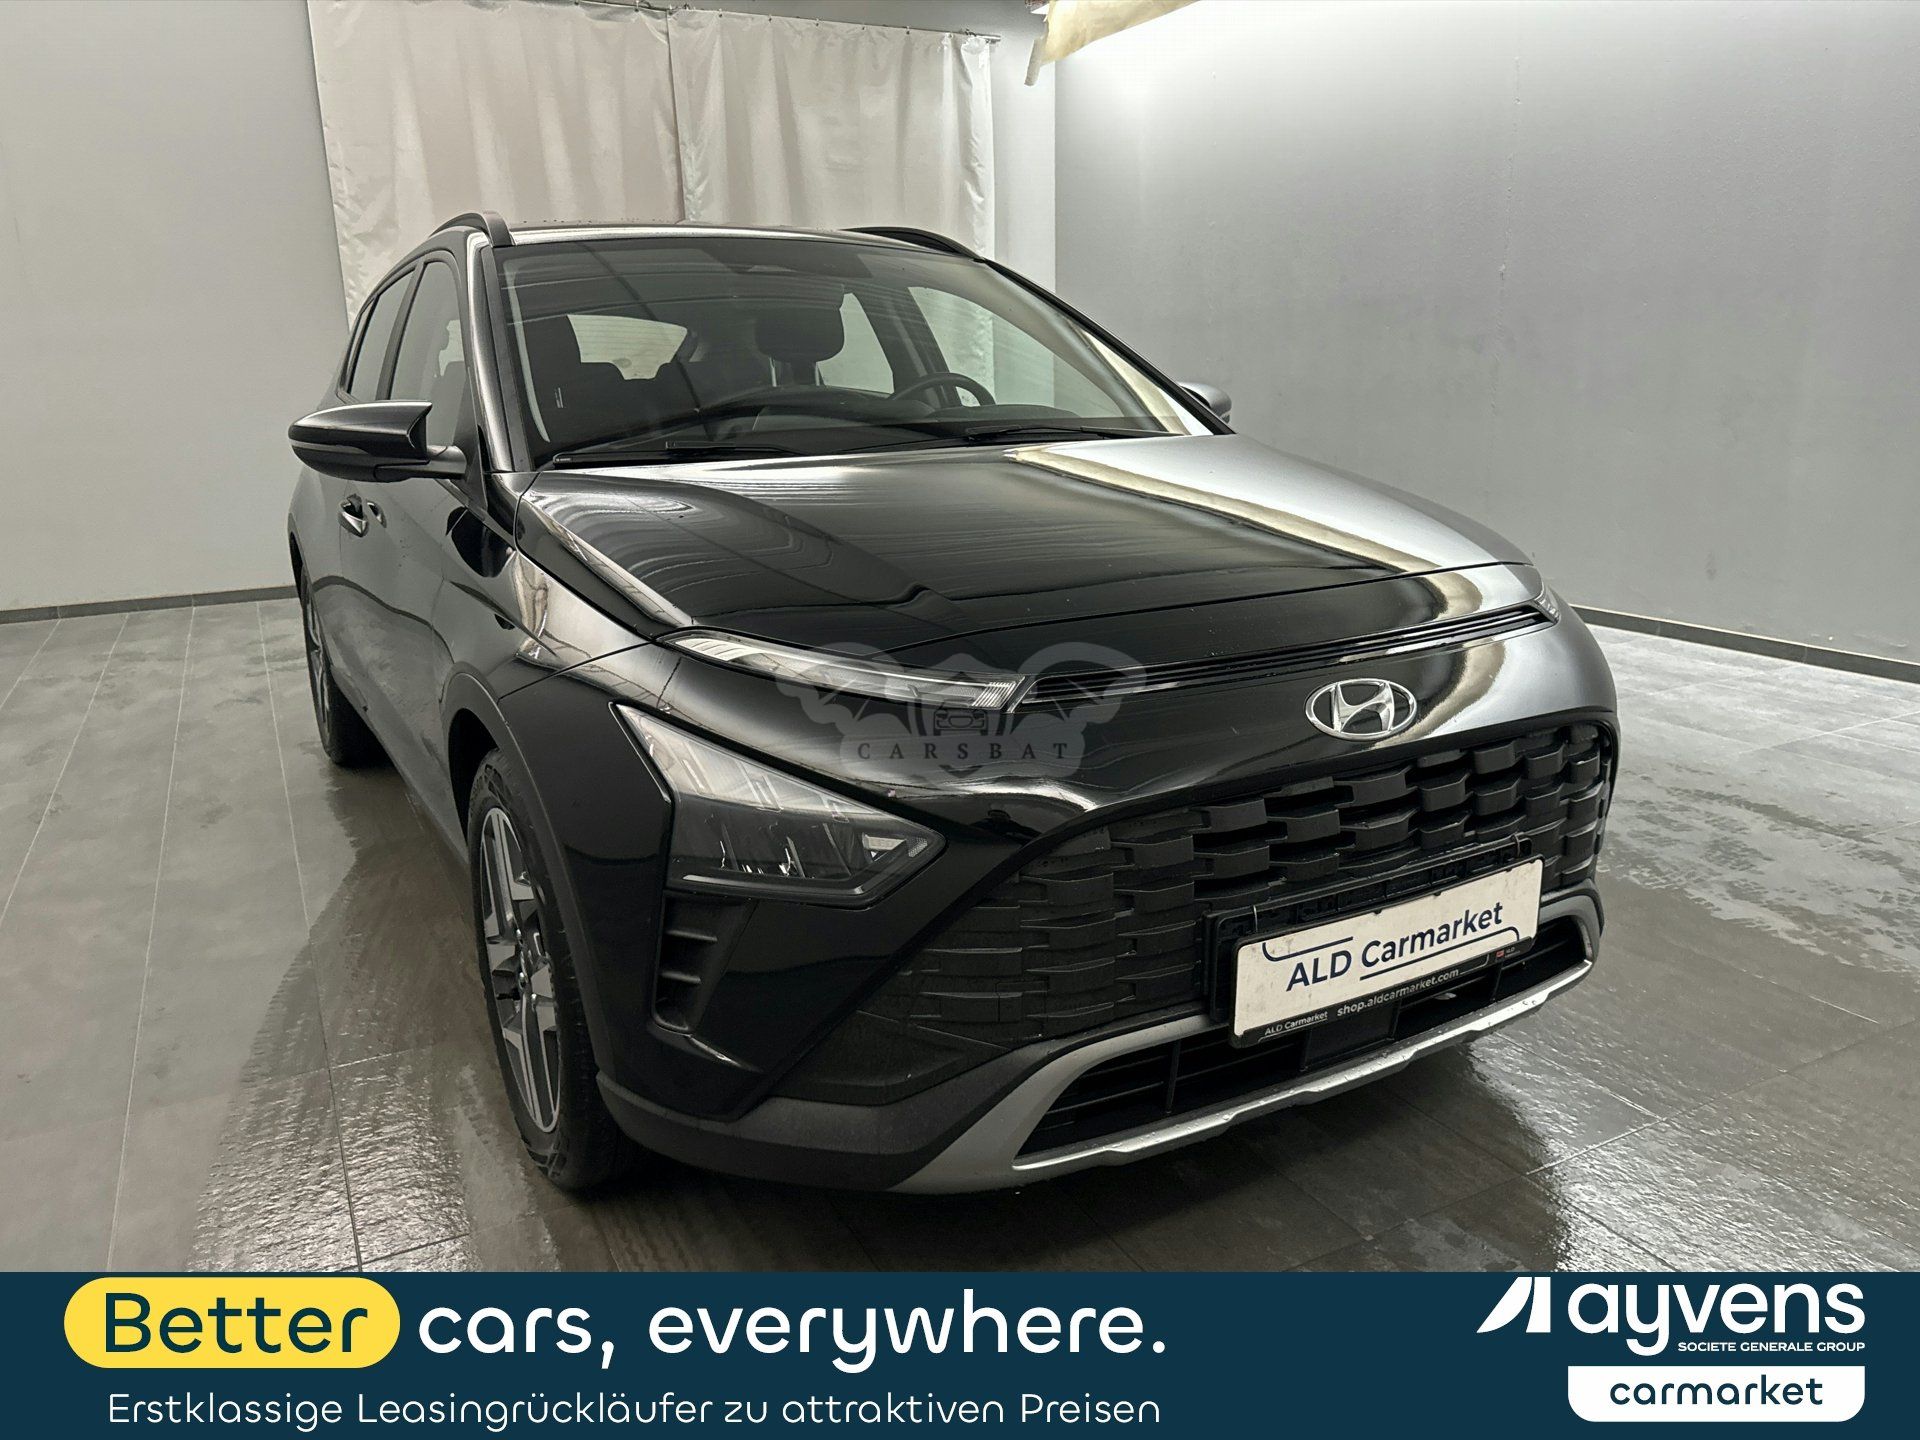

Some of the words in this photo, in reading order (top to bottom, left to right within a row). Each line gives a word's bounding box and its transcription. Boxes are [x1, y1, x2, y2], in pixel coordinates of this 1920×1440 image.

[1286, 950, 1352, 992] ALD
[1360, 902, 1503, 968] Carmarket
[1337, 968, 1459, 1018] shop.aldcarmarket.com
[1264, 1024, 1283, 1037] ALD
[1284, 1011, 1328, 1031] Carmarket
